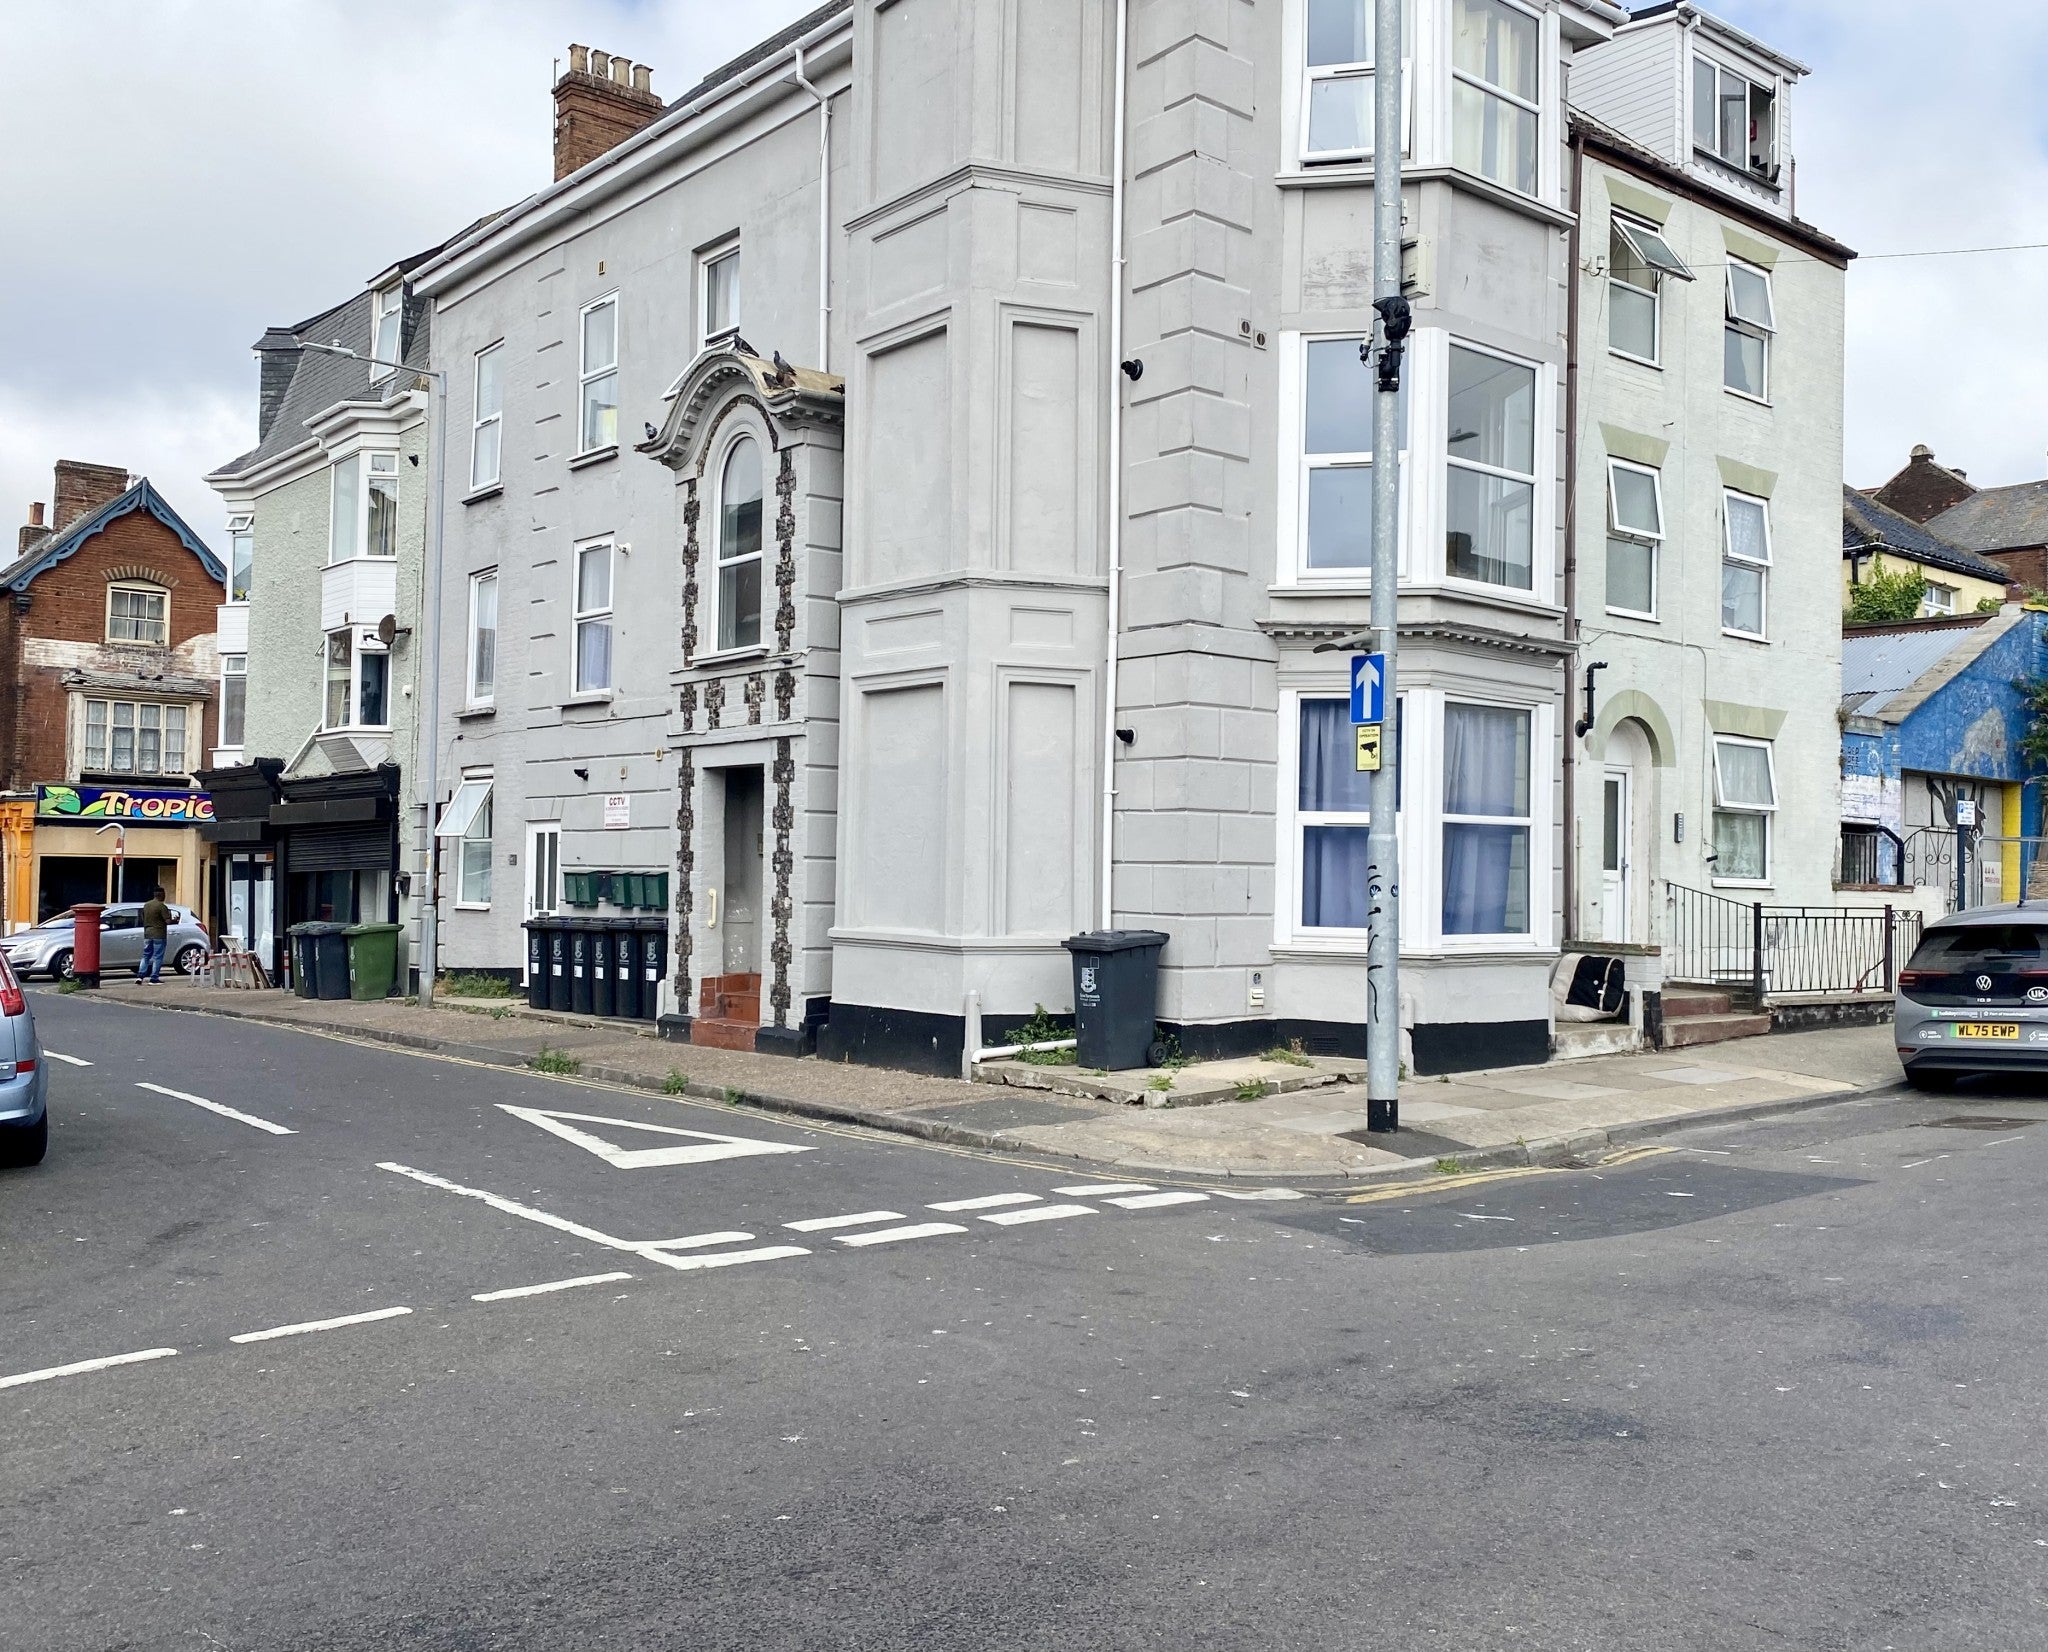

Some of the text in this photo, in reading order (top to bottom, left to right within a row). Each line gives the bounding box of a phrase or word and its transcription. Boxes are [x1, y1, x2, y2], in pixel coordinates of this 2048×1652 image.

[100, 791, 214, 819] Tropic
[609, 797, 625, 806] CCTV
[2030, 990, 2046, 998] UK
[1958, 1023, 2016, 1037] WL75 EWP
